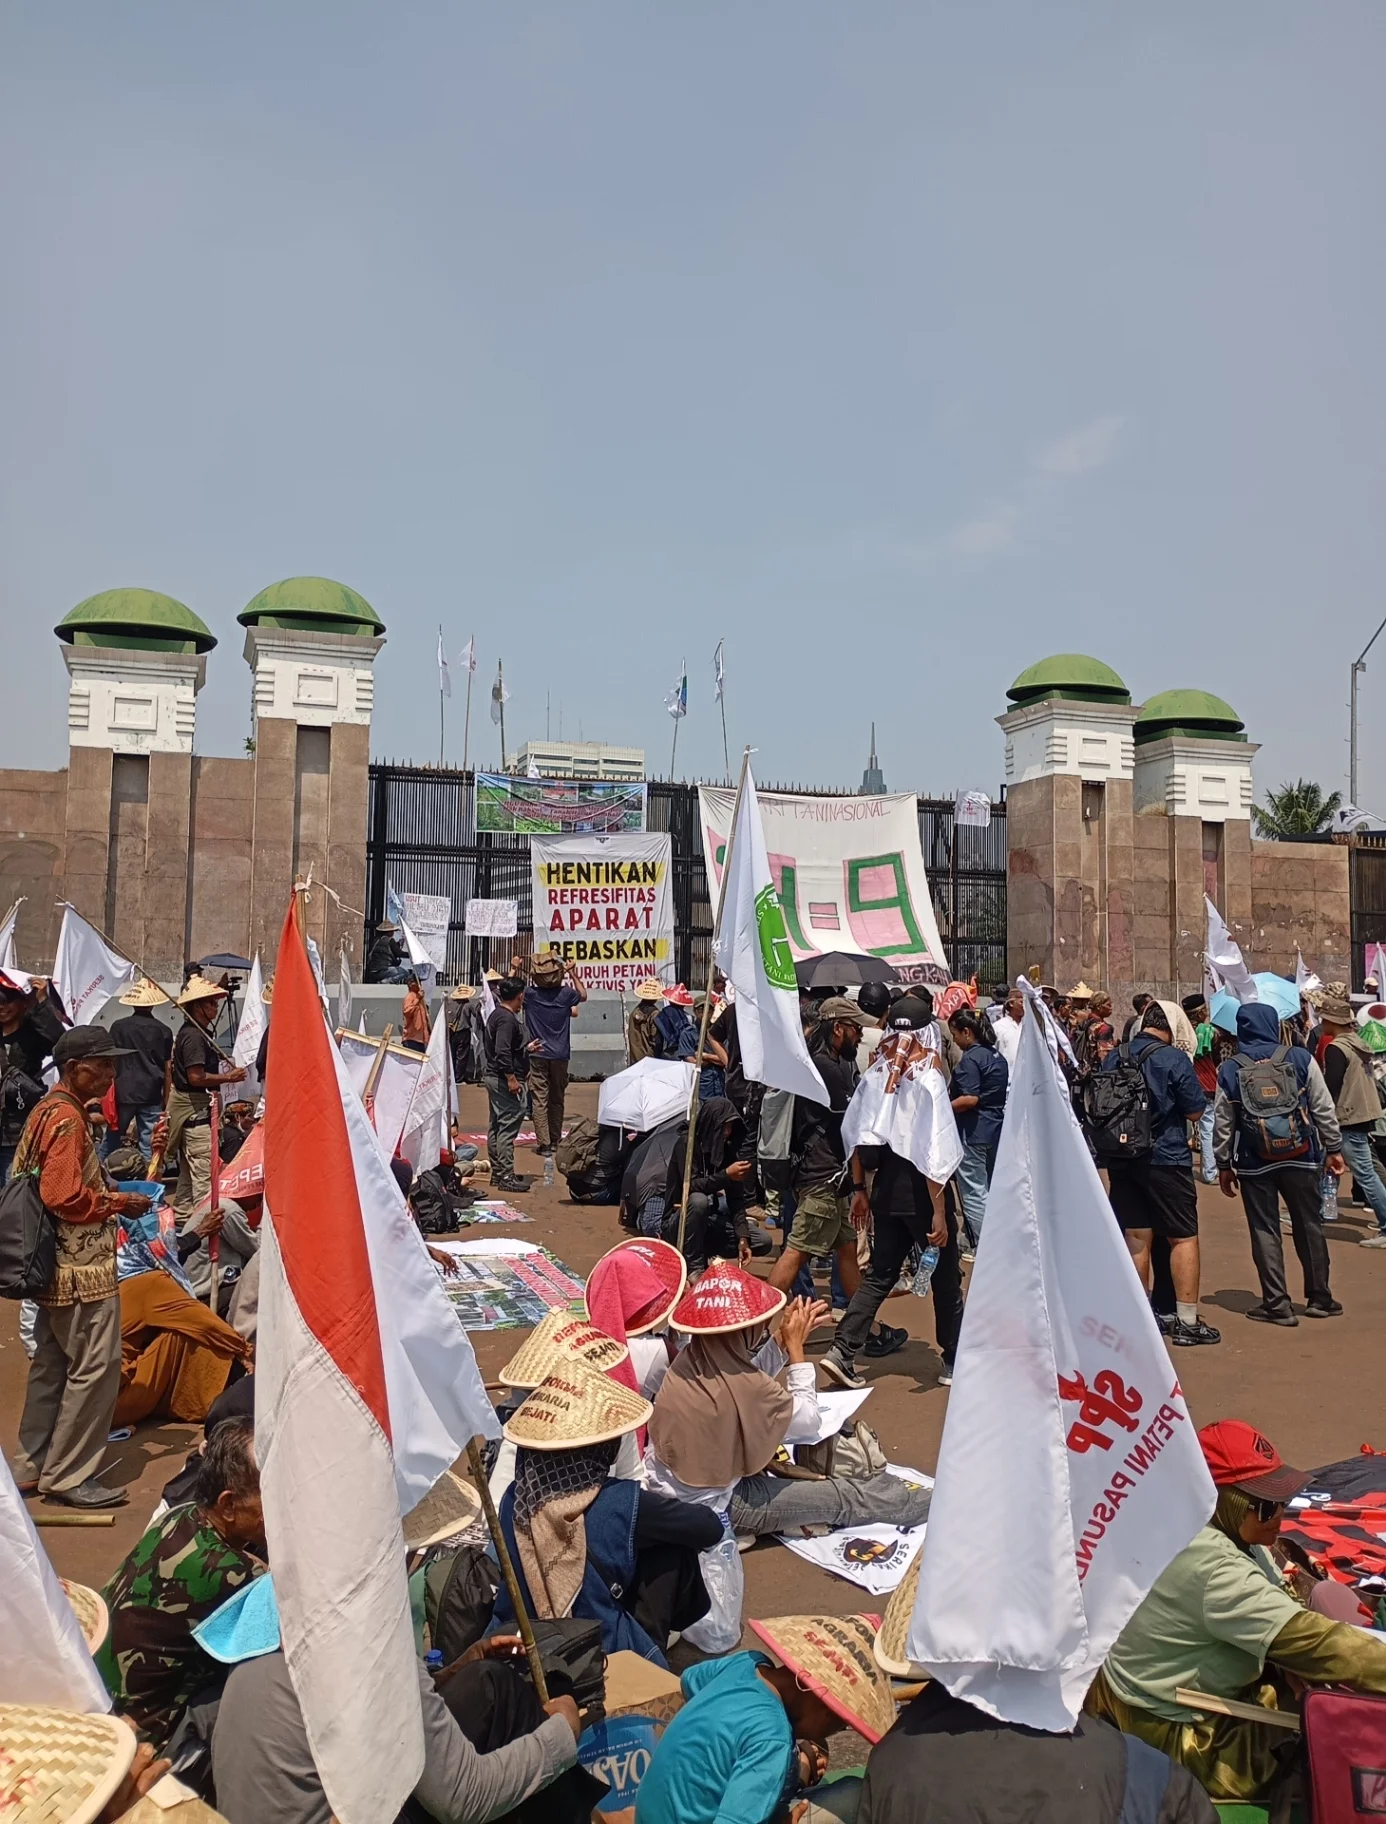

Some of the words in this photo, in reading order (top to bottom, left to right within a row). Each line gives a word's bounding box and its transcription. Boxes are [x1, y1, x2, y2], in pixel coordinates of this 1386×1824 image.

[546, 861, 657, 885] HENTIKAN
[548, 887, 656, 905] REFRESIFITAS
[549, 906, 653, 931] APARAT
[613, 963, 656, 978] PETANI
[696, 1296, 731, 1310] TANI
[581, 1748, 652, 1792] OAS
